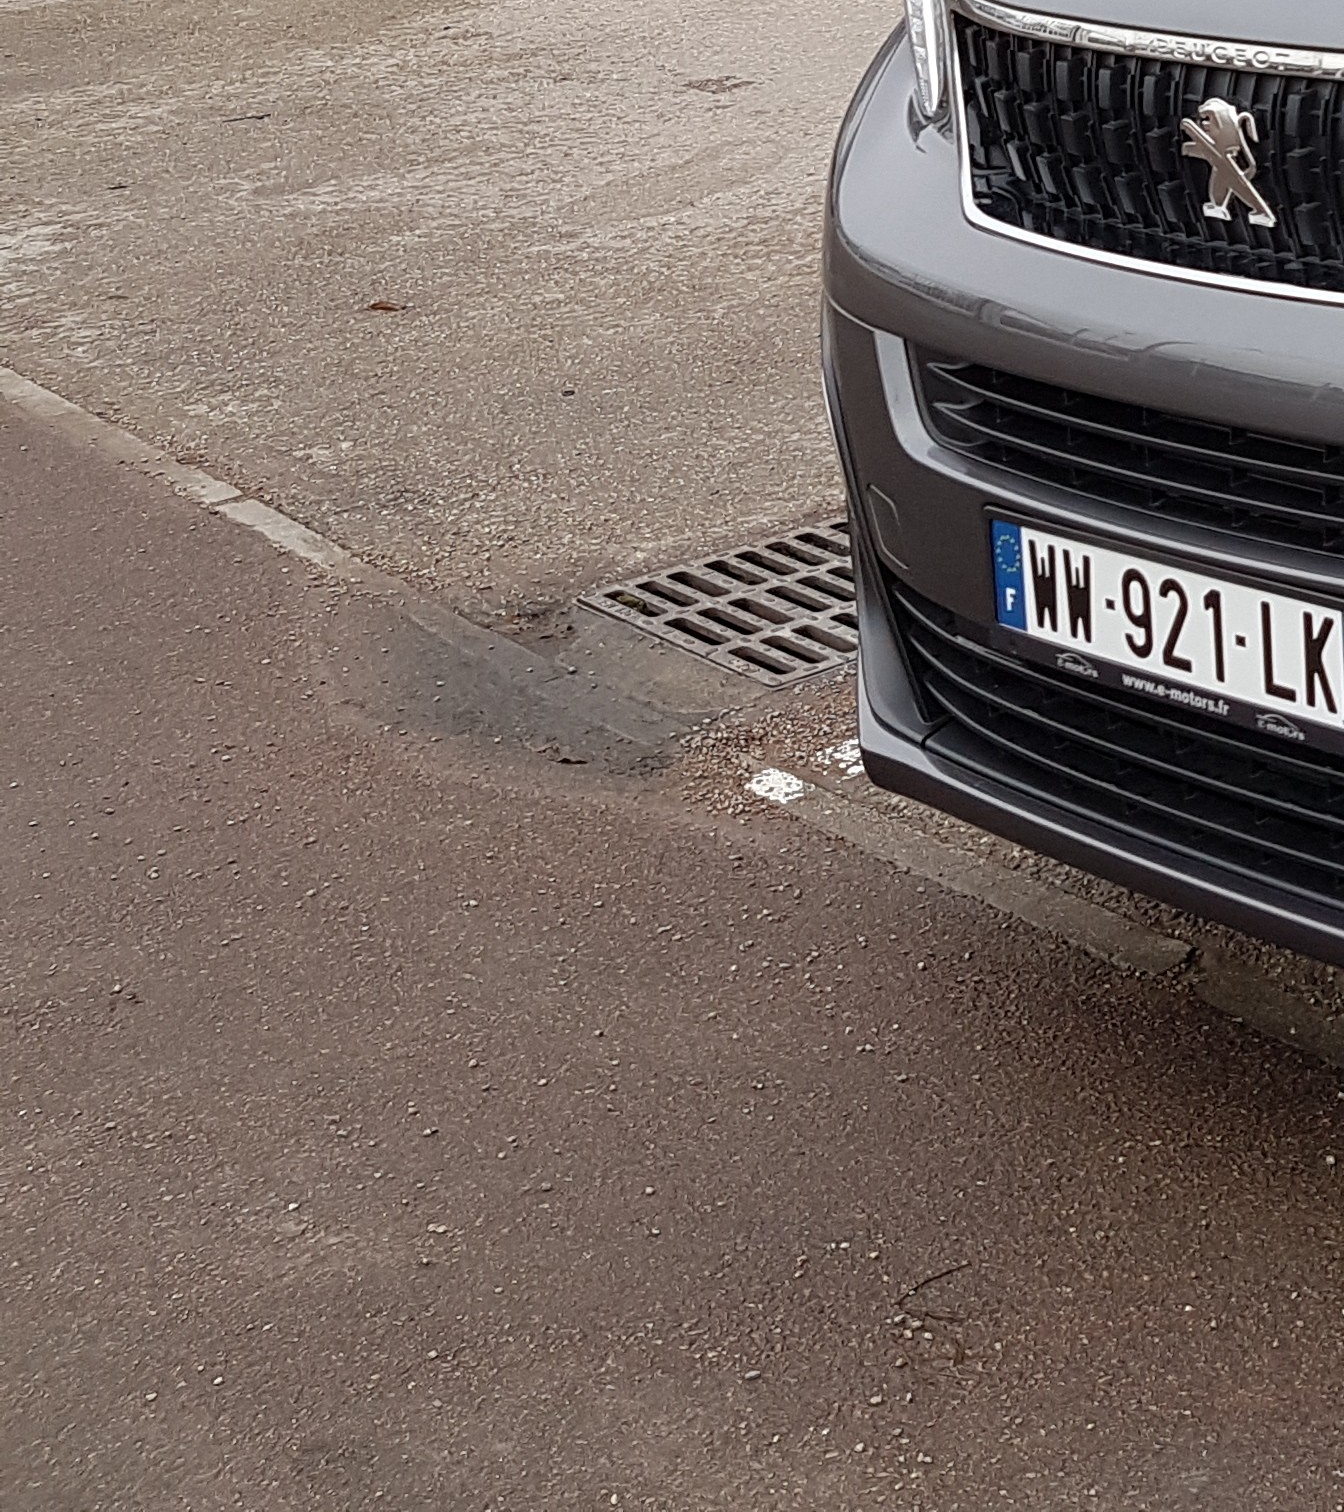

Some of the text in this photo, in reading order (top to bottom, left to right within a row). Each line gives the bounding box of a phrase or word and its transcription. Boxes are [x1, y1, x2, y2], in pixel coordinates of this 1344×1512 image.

[1154, 38, 1291, 71] PEUGEOT
[1005, 587, 1017, 614] F
[1121, 672, 1230, 717] www.e-motors.fr
